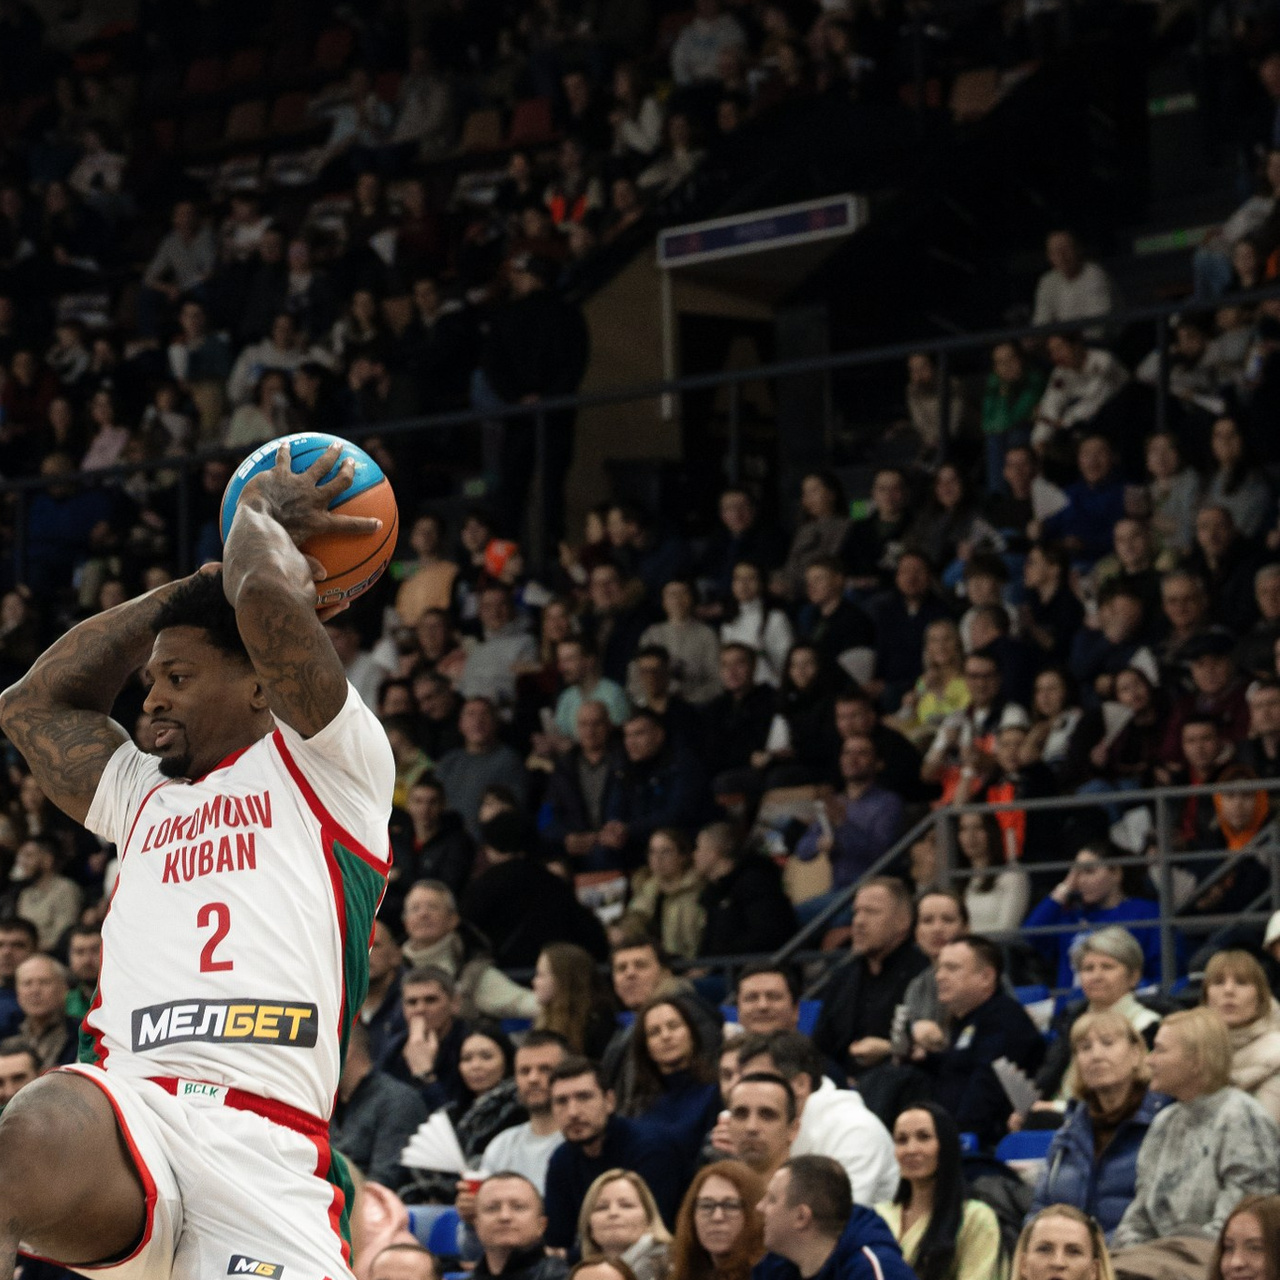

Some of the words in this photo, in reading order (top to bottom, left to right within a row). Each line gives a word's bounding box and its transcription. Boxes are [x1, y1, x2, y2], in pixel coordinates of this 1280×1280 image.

[162, 832, 257, 884] KUBAN
[196, 901, 234, 973] 2
[138, 1004, 312, 1046] МЕЛБЕТ
[184, 1082, 219, 1098] BCLK
